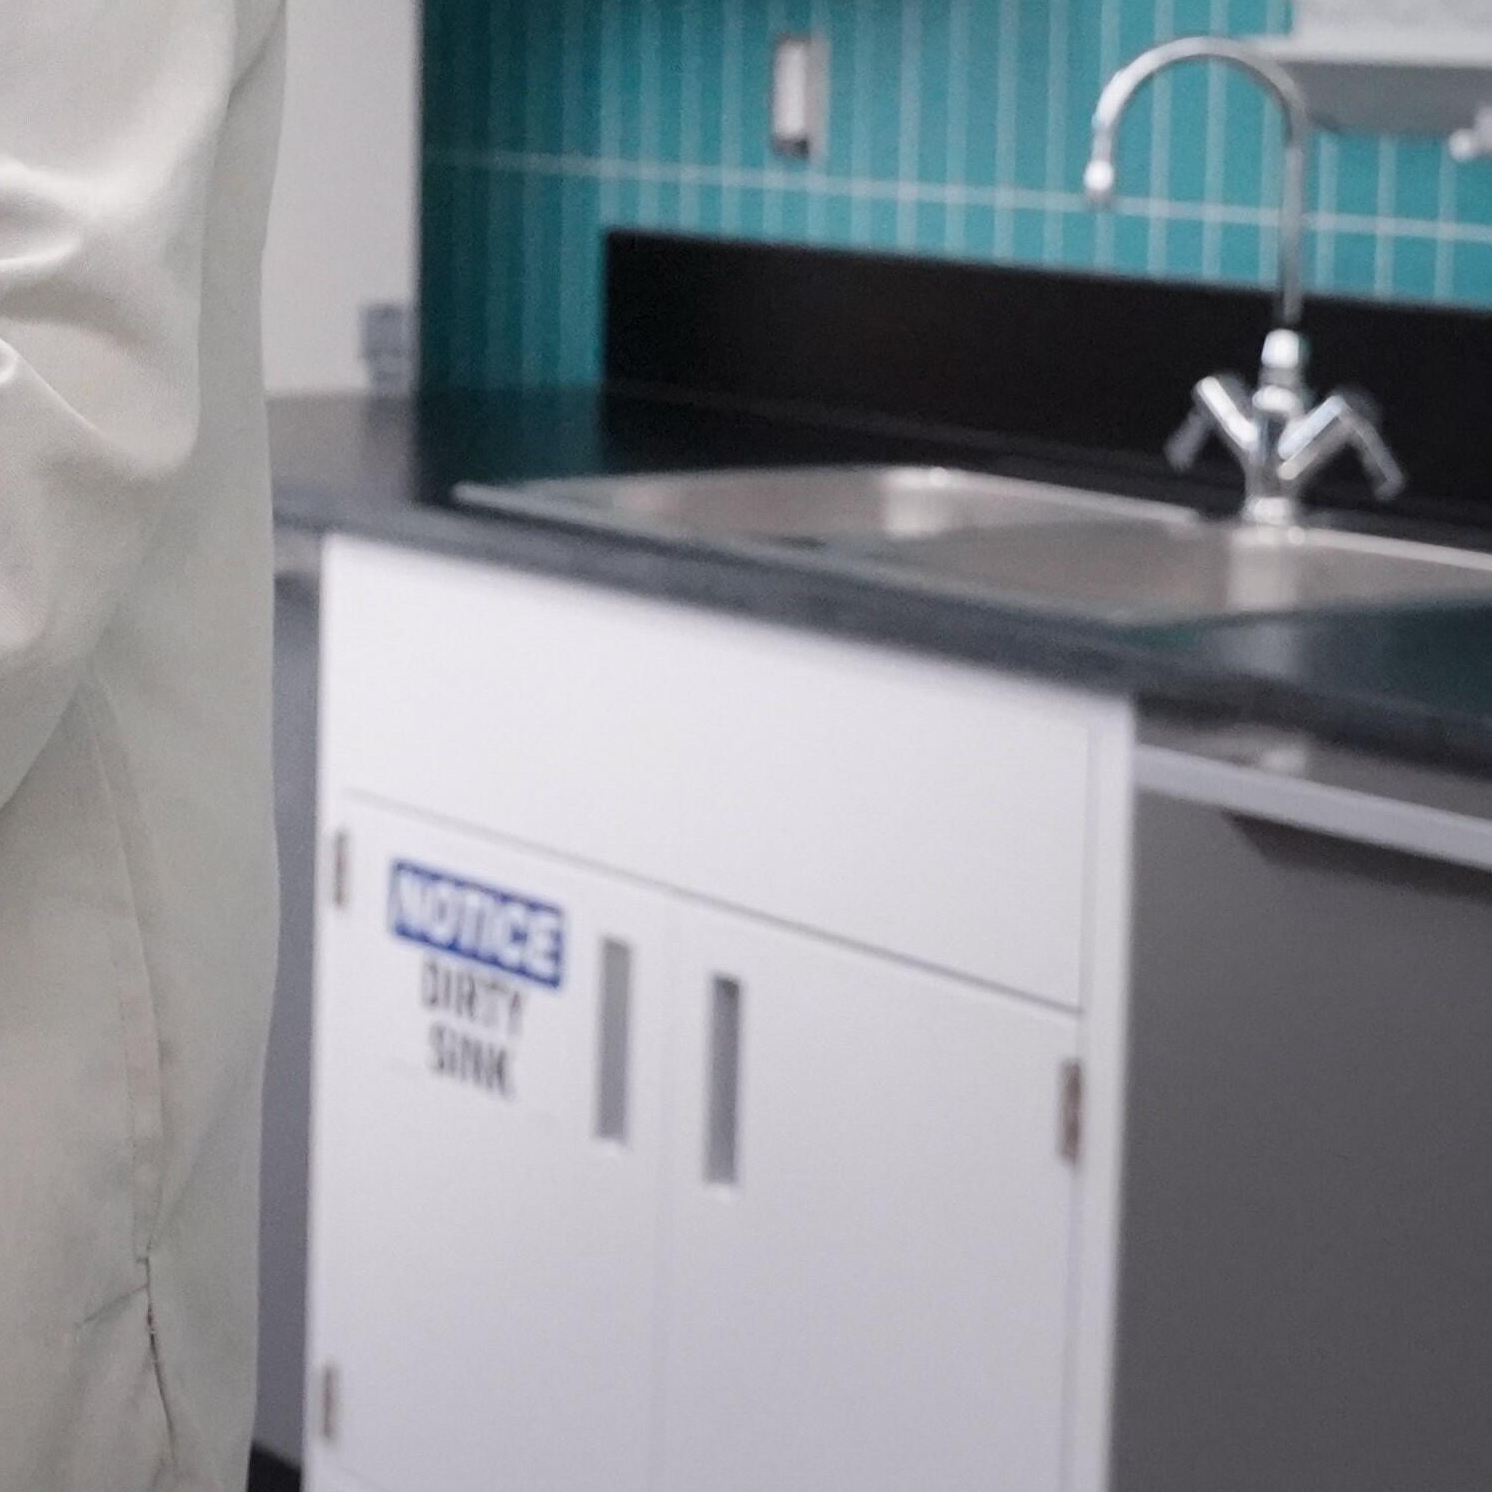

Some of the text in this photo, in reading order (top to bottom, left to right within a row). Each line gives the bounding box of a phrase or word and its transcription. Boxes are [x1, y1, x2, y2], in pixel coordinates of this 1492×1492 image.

[394, 869, 560, 979] NOTICE
[419, 960, 524, 1038] DIRTY
[428, 1022, 510, 1096] SINK
